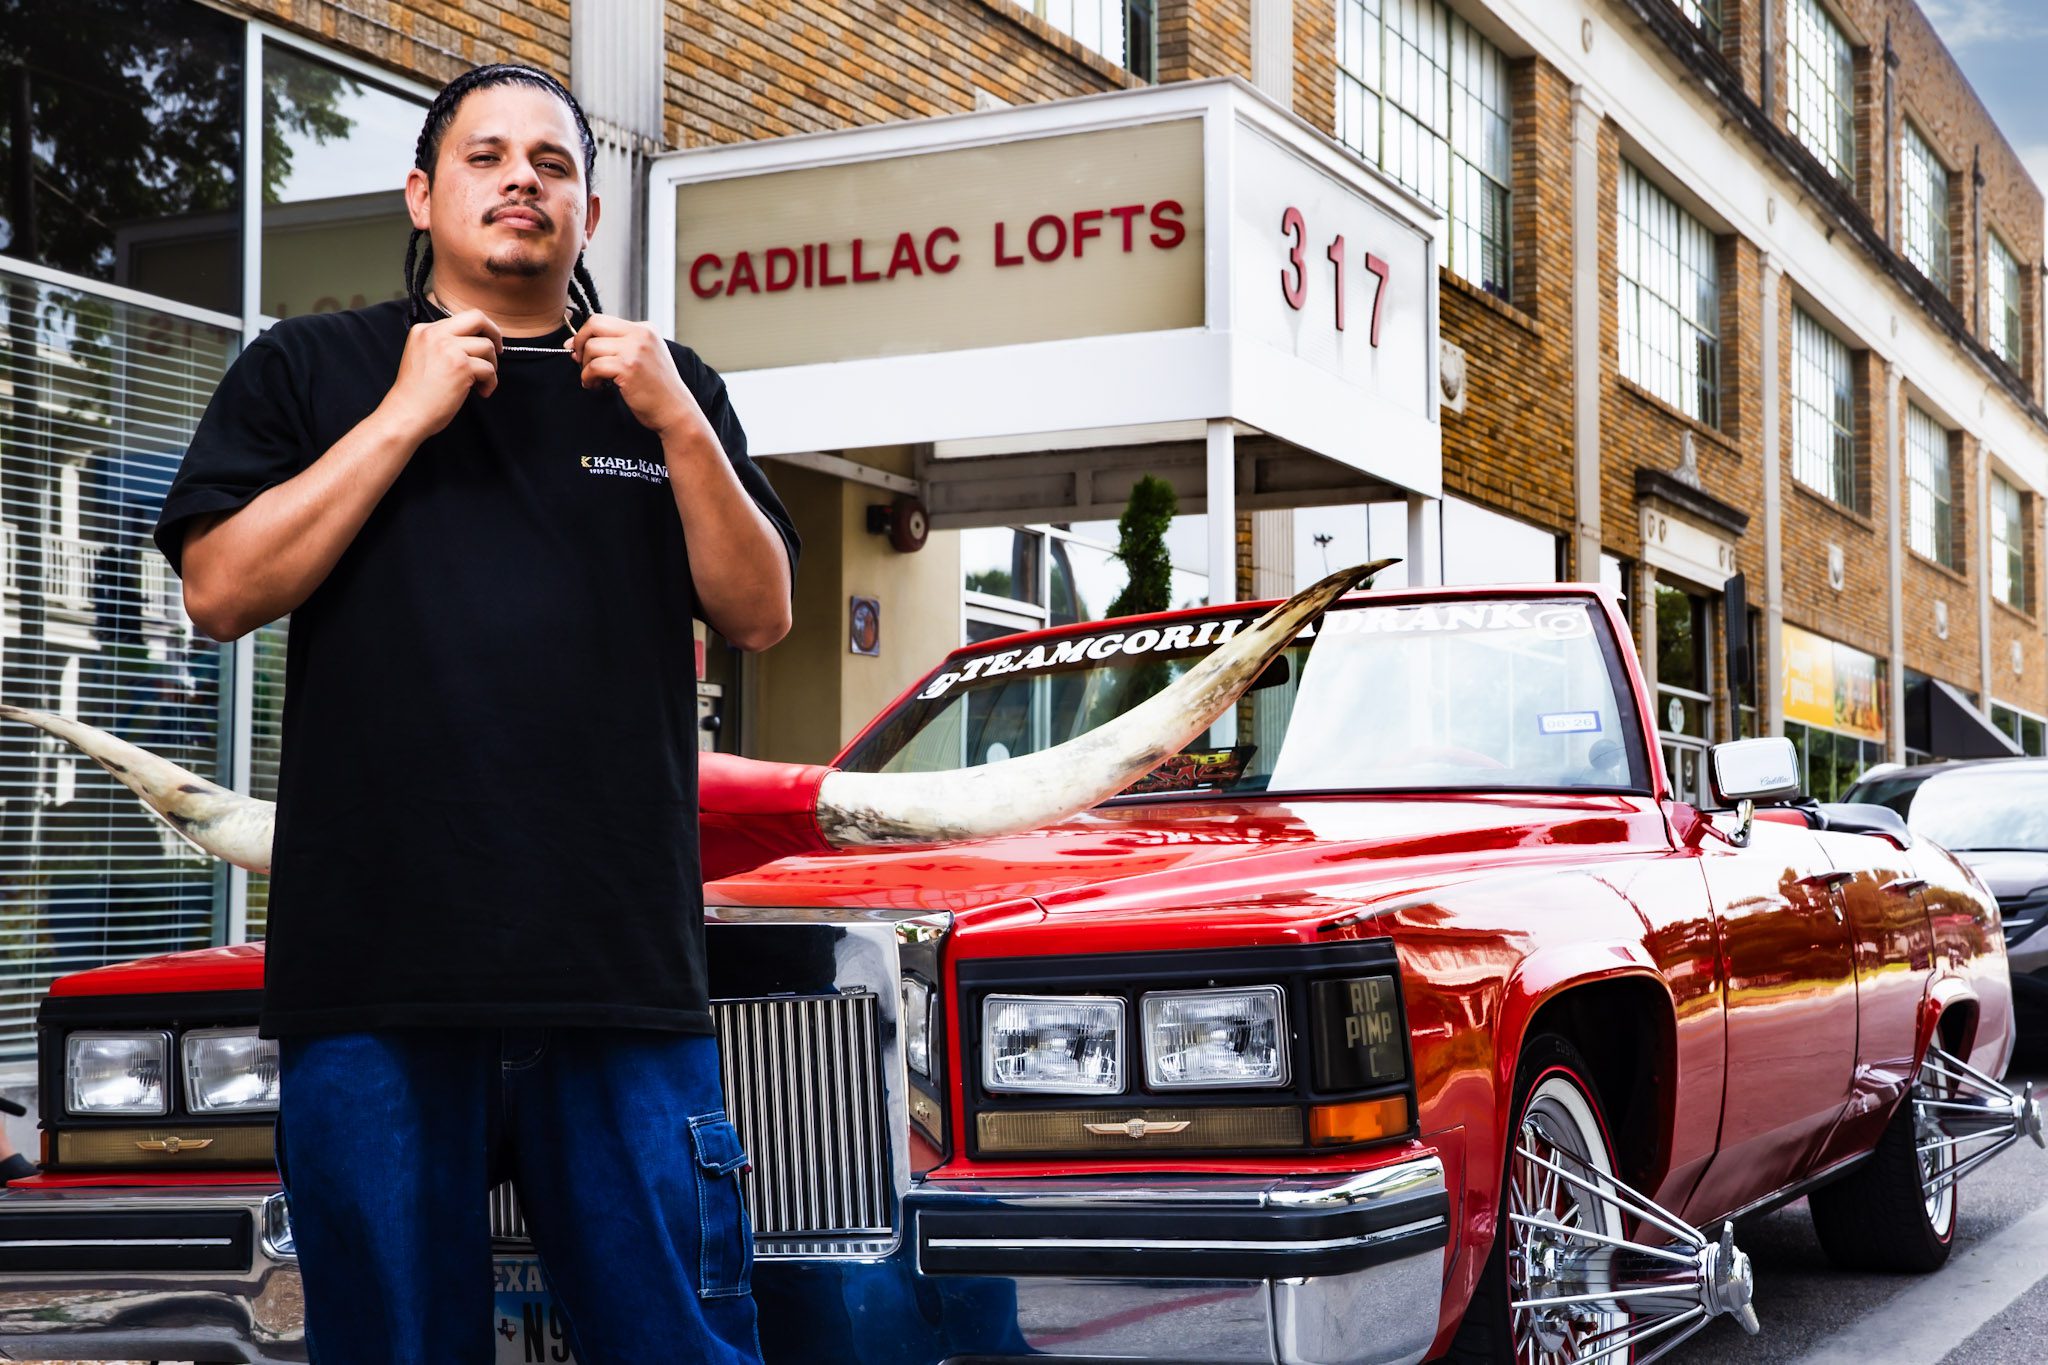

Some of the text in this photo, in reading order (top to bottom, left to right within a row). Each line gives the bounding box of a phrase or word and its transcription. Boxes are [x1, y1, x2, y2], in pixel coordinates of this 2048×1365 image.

[689, 200, 1186, 300] CADILLAC LOFTS
[1281, 207, 1390, 349] 317
[593, 456, 638, 471] KARL
[1350, 981, 1380, 1014] RIP
[1345, 1011, 1392, 1049] PIMP
